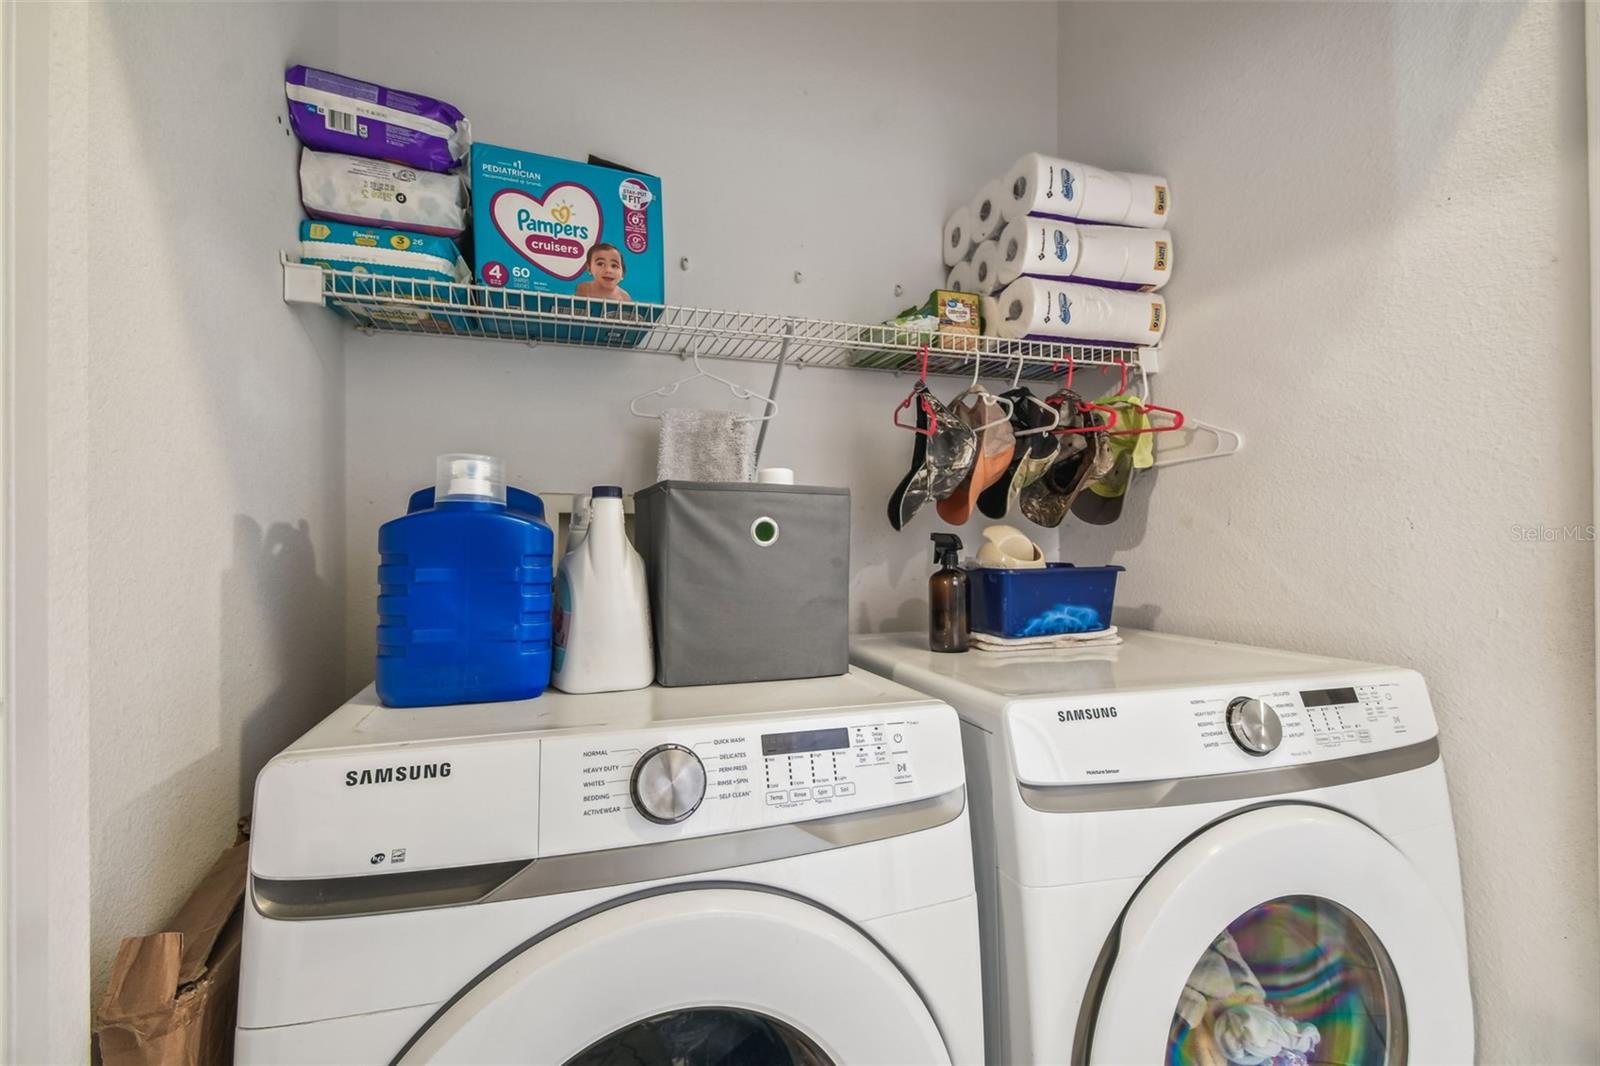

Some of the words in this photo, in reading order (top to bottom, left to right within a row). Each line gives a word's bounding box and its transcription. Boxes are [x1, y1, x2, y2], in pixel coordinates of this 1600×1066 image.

[482, 163, 541, 180] PEDIATRICIAN
[628, 195, 640, 204] FIT
[517, 208, 589, 240] Pampers
[531, 239, 579, 254] cruisers
[488, 264, 502, 279] 4
[512, 266, 530, 278] 60
[1057, 706, 1118, 722] SAMSUNG
[719, 752, 747, 760] DELICATES
[345, 762, 452, 786] SAMSUNG
[583, 793, 610, 802] BEDDING
[583, 806, 621, 816] ACTIVEWEAR
